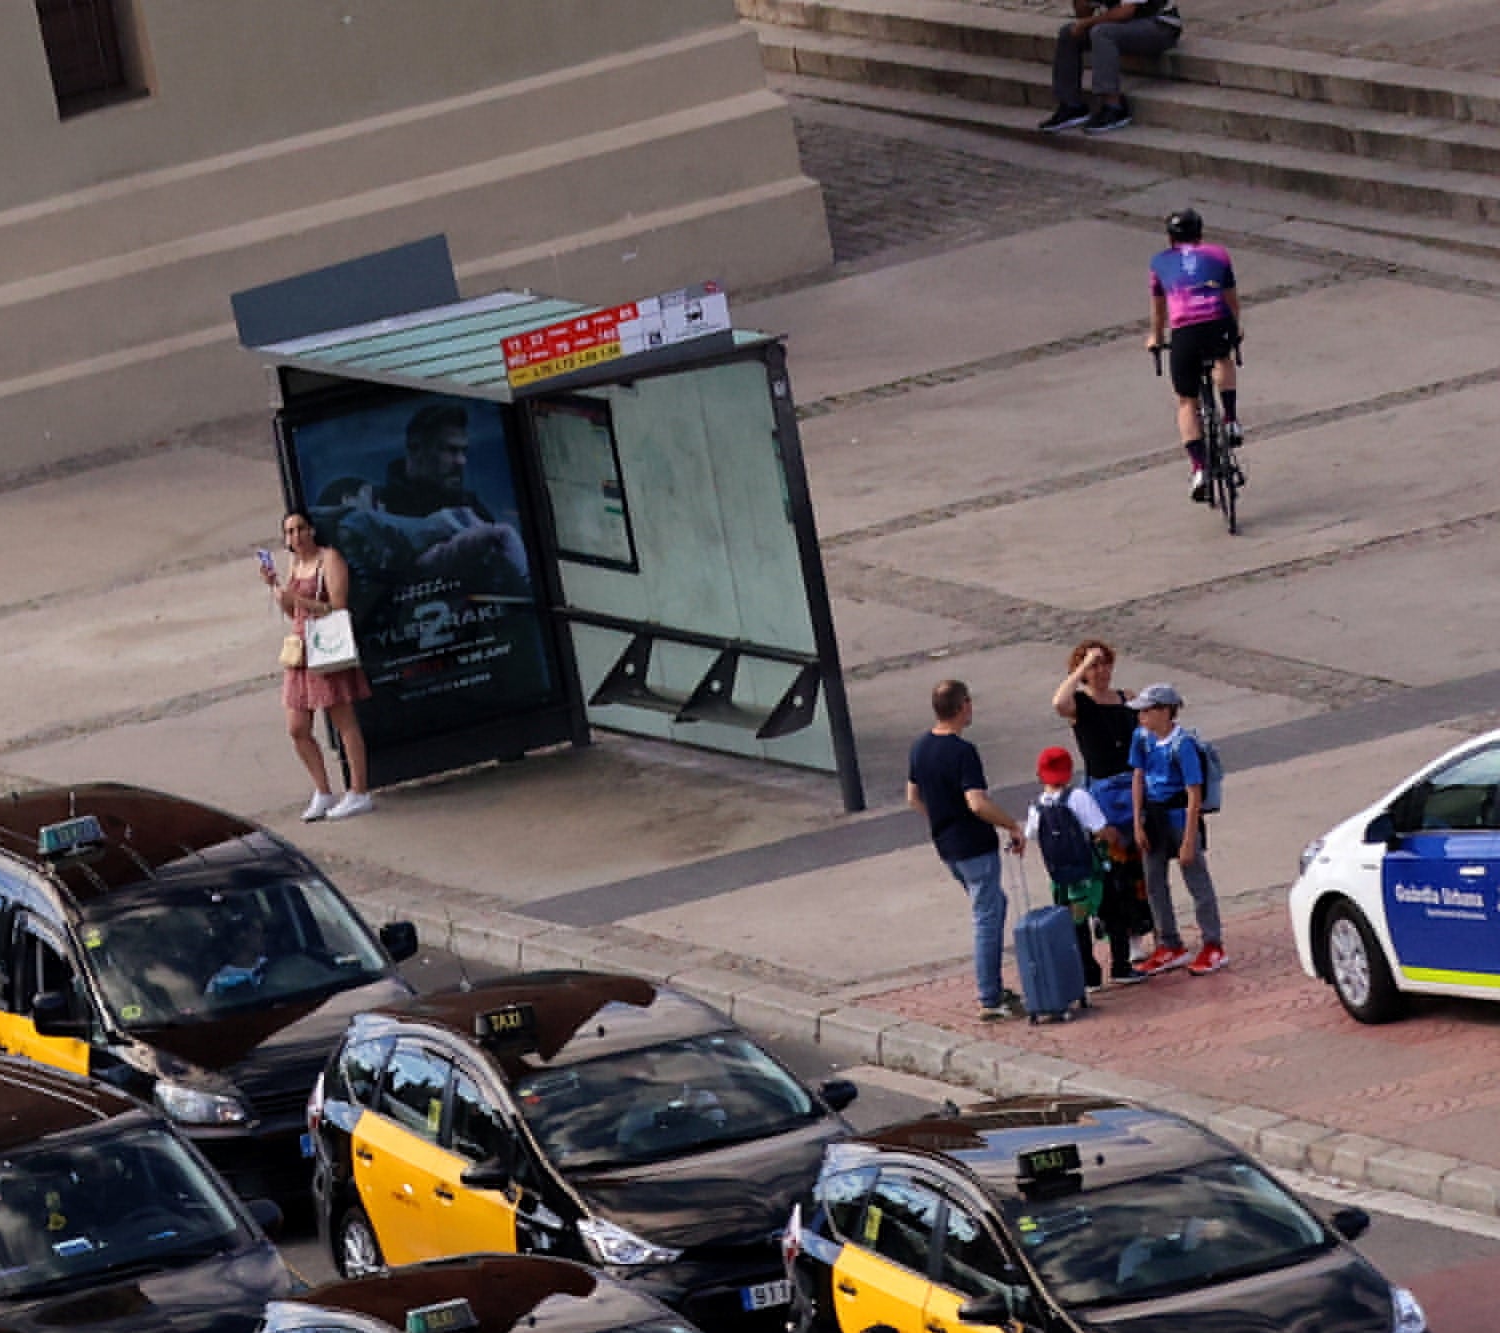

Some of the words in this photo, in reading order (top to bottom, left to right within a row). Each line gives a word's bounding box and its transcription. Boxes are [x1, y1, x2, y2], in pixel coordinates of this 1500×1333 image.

[414, 600, 454, 650] 2
[490, 1010, 521, 1030] TAXI
[1030, 1150, 1062, 1170] TAXI
[426, 1309, 454, 1327] TAXI
